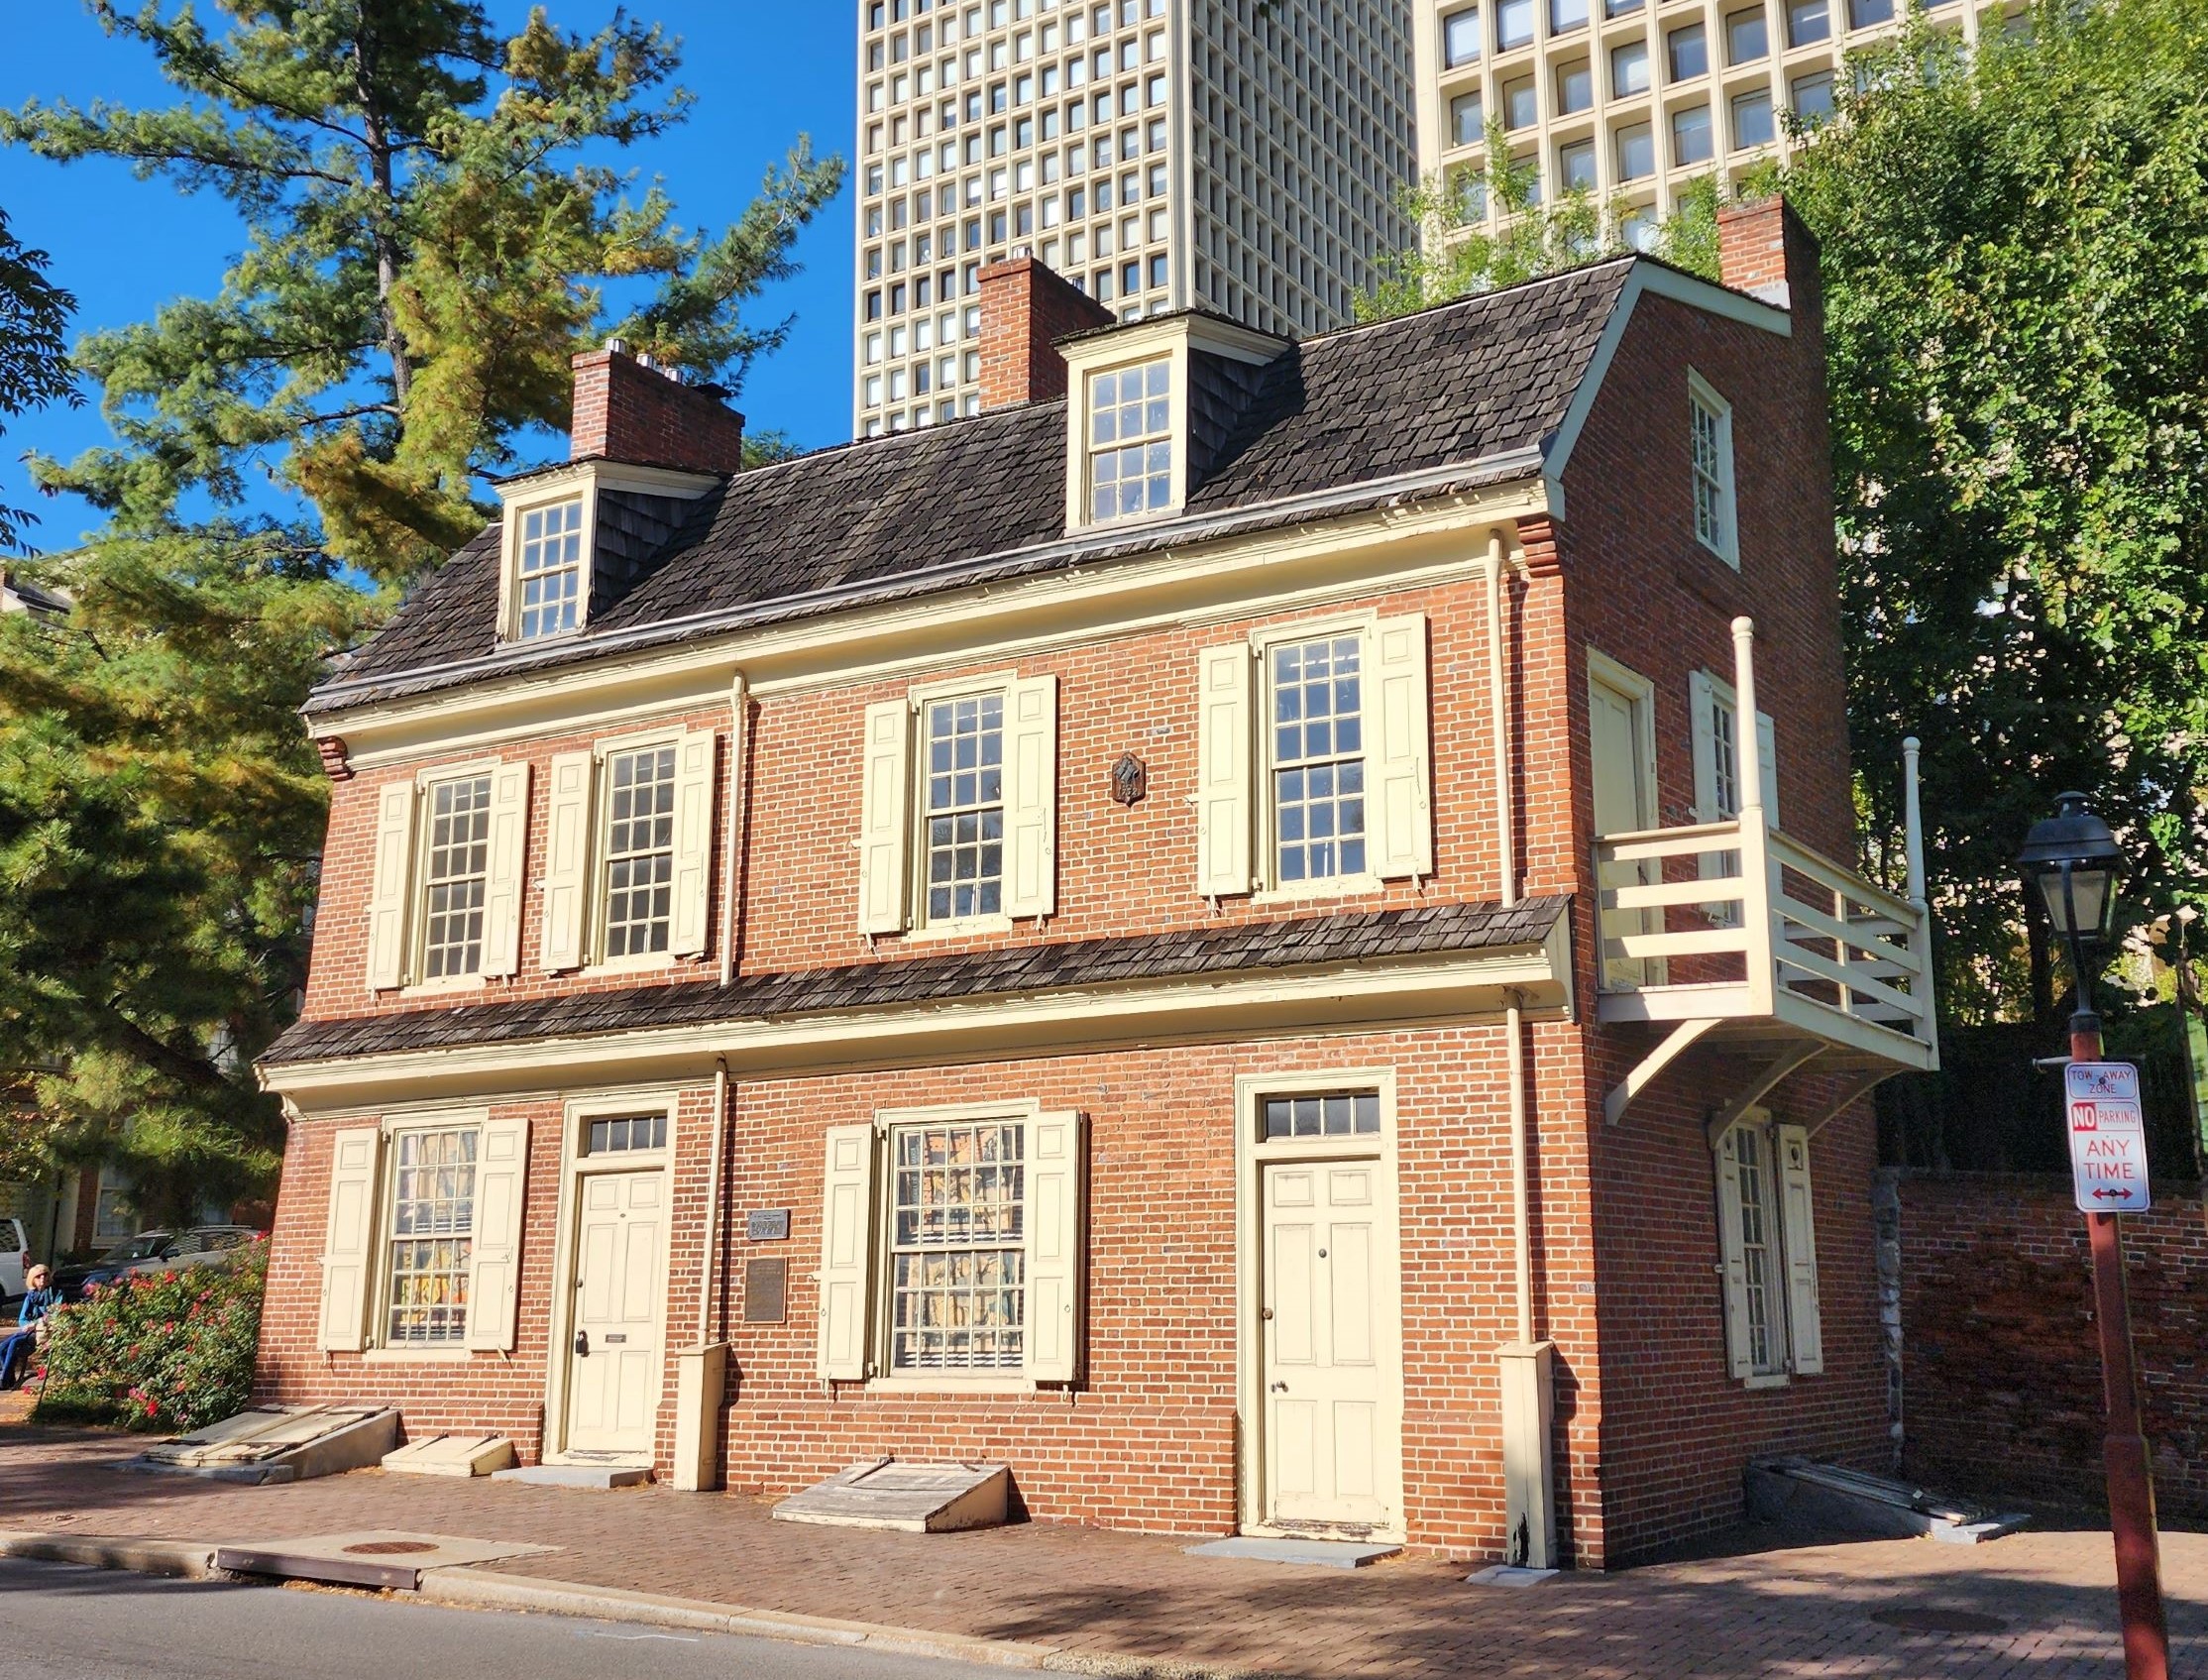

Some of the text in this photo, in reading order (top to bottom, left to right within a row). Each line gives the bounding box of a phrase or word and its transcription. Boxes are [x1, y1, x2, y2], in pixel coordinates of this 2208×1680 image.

[2070, 1070, 2093, 1080] TOW
[2103, 1070, 2132, 1080] AWAY
[2089, 1083, 2117, 1094] ZONE
[2072, 1105, 2136, 1128] NO PARKING
[2087, 1139, 2130, 1157] ANY
[2083, 1163, 2136, 1179] TIME
